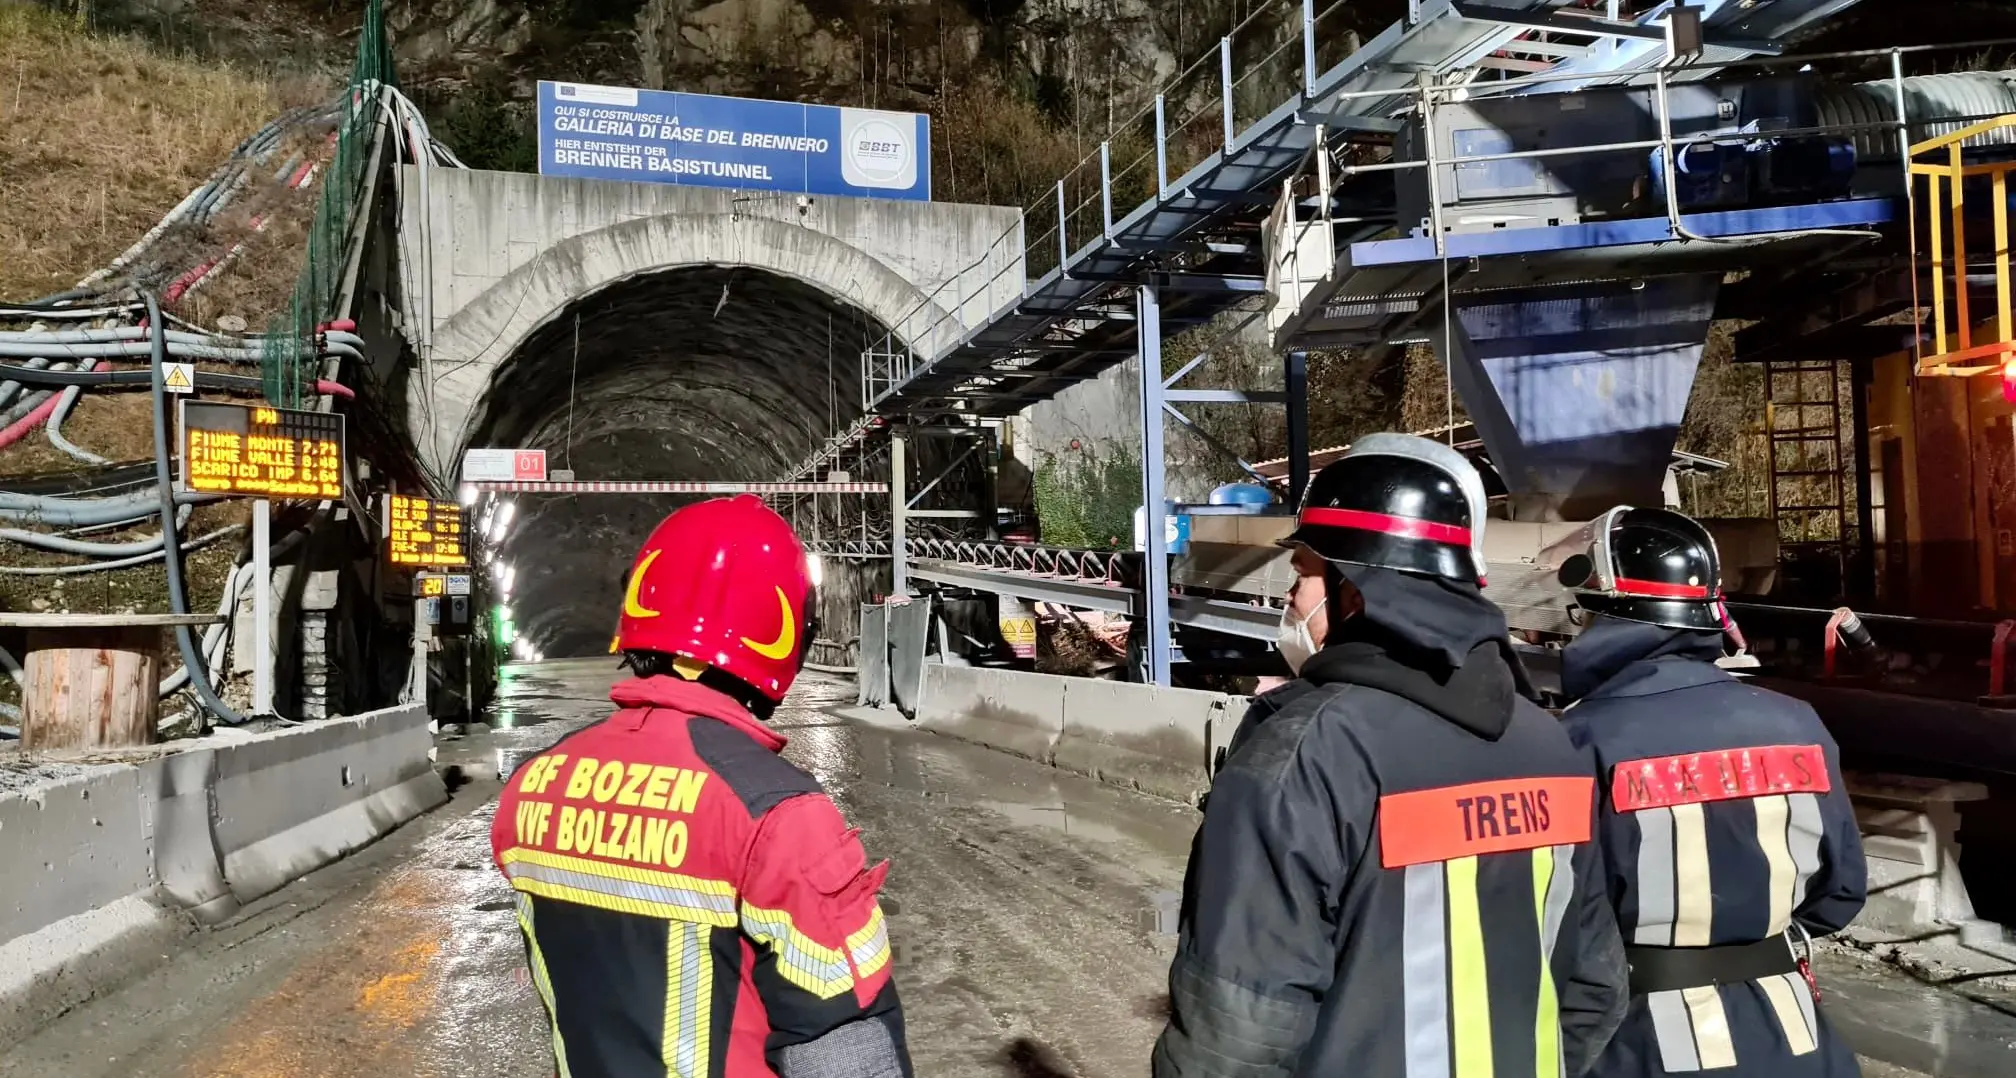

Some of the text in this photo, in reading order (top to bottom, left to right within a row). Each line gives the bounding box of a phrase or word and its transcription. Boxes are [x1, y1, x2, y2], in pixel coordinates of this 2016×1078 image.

[554, 106, 679, 126] QUI SI COSTRUISCE LA
[554, 116, 828, 154] GALLERIA DI BASE DEL BRENNERO
[555, 138, 666, 156] HIER ENTSTEHT DER
[871, 142, 901, 152] BBT
[555, 149, 772, 180] BRENNER BASISTUNNEL
[256, 408, 277, 424] PH
[190, 430, 240, 448] FIUME
[248, 436, 295, 453] MONTE
[190, 447, 240, 463] FIUME
[248, 451, 295, 467] VALLE
[520, 456, 540, 471] 01
[191, 461, 258, 478] SCARICO
[269, 466, 295, 480] IMP
[424, 578, 443, 595] 20
[520, 754, 708, 814] BF BOZEN
[1456, 789, 1550, 841] TRENS
[516, 800, 688, 868] VVF BOLZANO
